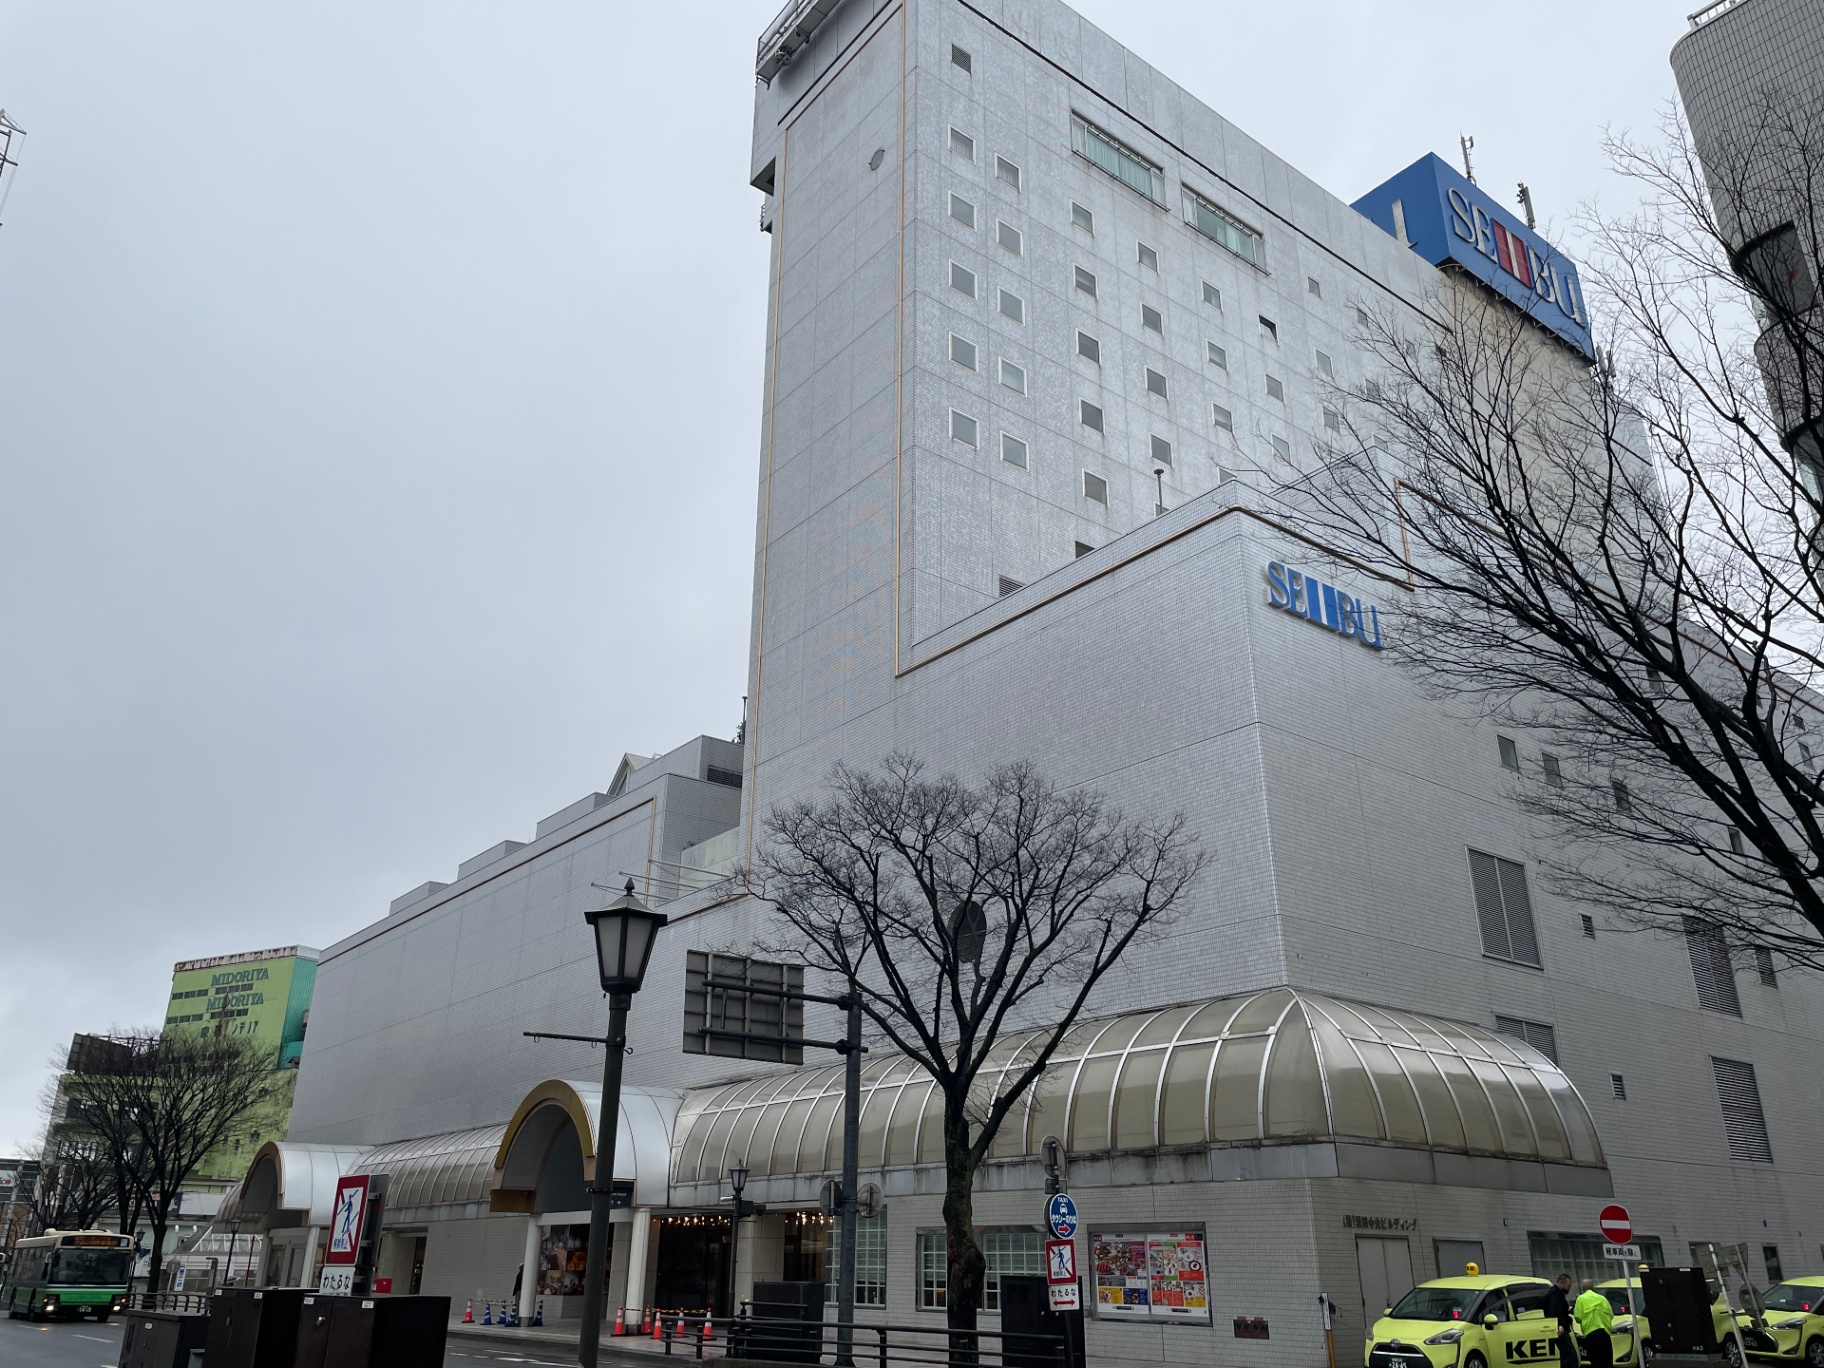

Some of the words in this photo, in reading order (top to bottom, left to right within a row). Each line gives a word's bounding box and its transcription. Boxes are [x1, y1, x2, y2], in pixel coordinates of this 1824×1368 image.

[1448, 187, 1585, 329] SEIBU
[1266, 560, 1383, 649] SEIBU
[211, 967, 269, 986] MIDORIYA
[206, 992, 264, 1011] MIDORIYA
[1051, 1214, 1077, 1224] タクシーのりば
[322, 1273, 350, 1290] わたるな
[1051, 1288, 1076, 1297] わたるな
